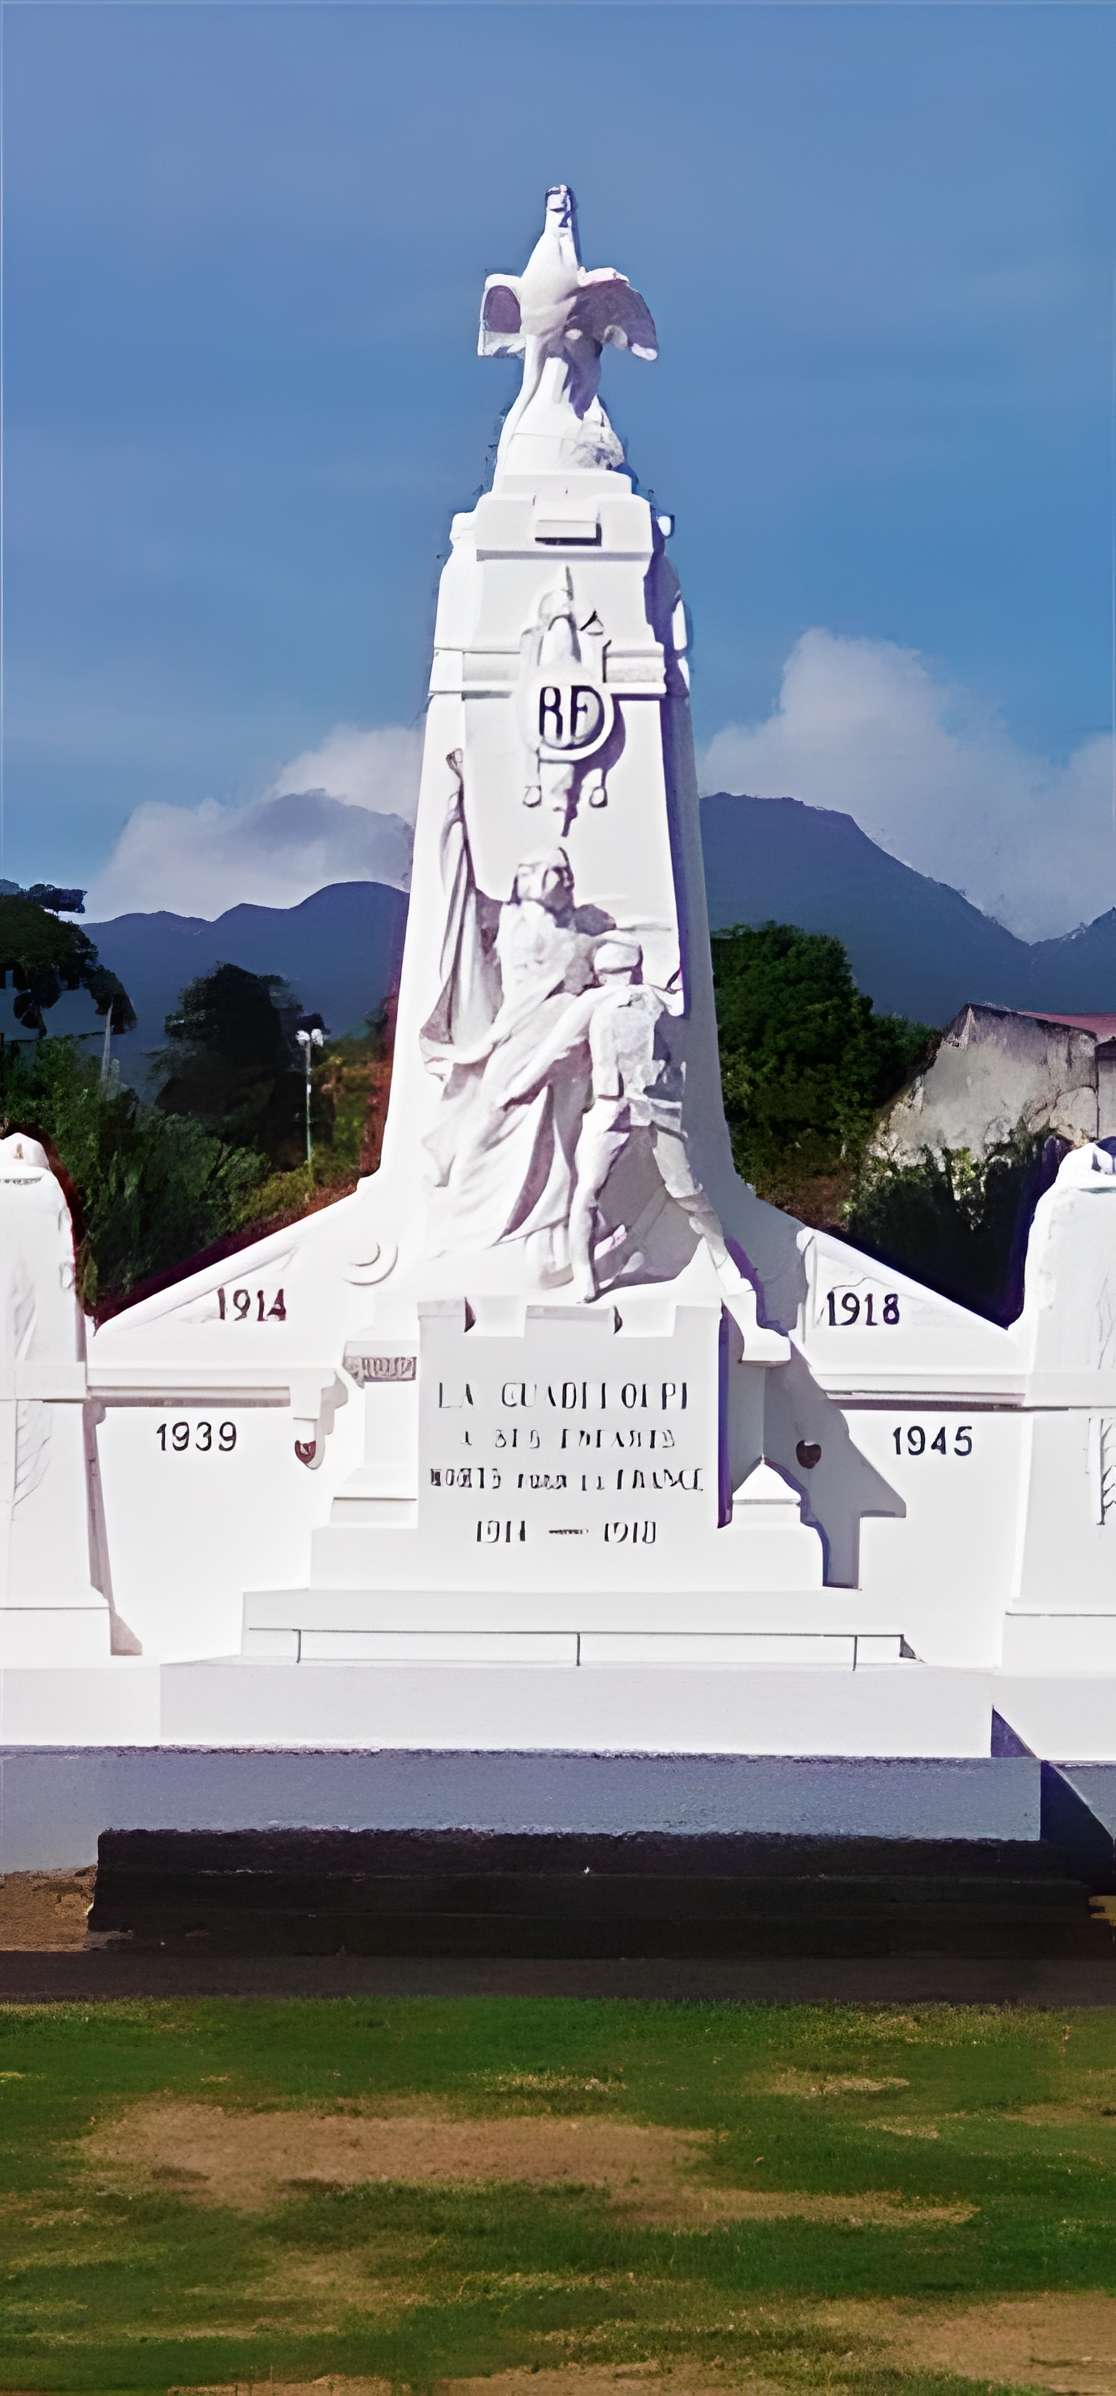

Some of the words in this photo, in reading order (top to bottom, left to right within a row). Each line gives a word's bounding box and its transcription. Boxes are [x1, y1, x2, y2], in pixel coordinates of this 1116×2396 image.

[539, 685, 600, 740] RF
[826, 1291, 900, 1327] 1918
[156, 1421, 238, 1452] 1939
[892, 1425, 973, 1456] 1945
